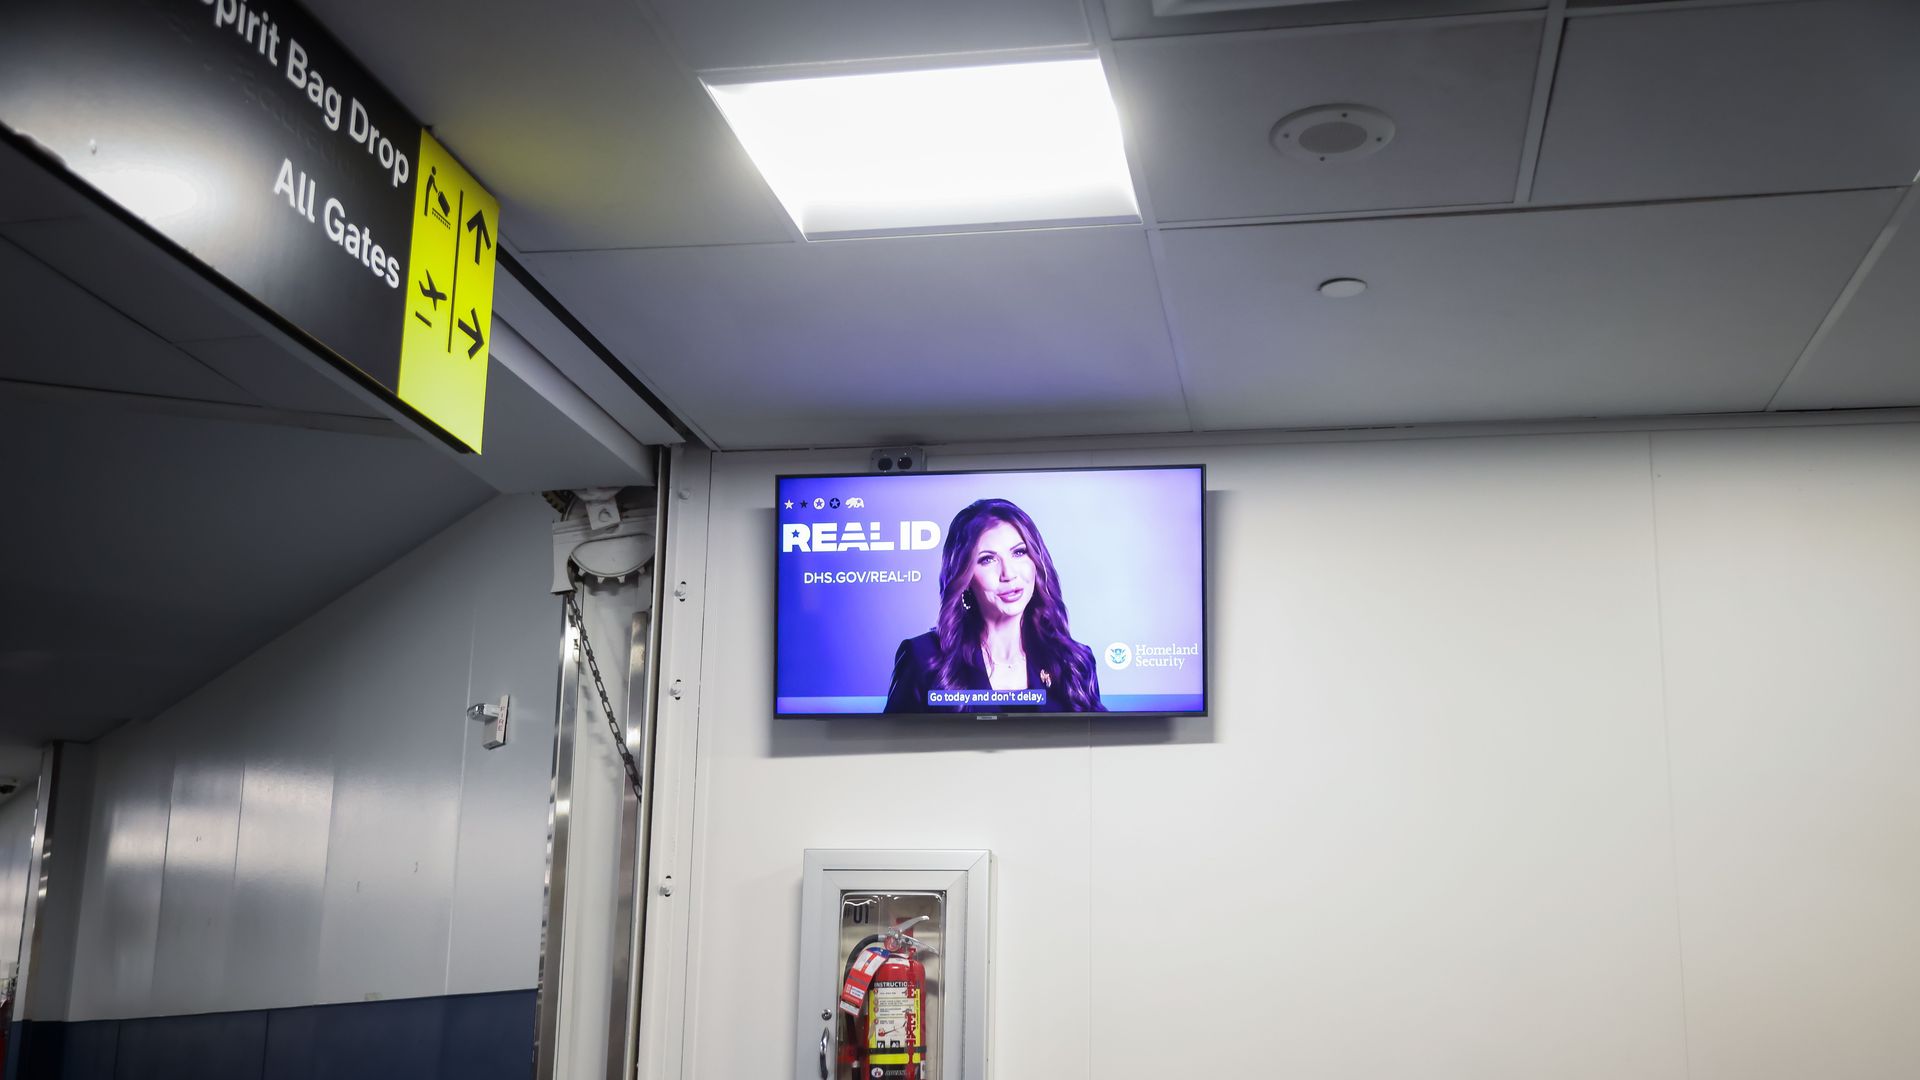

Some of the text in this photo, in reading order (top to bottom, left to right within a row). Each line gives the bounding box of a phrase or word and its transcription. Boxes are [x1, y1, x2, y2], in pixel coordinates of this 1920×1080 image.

[286, 37, 342, 131] Bag
[350, 97, 409, 187] Drop
[273, 157, 400, 289] All Gates
[782, 520, 941, 552] REAL ID
[803, 570, 921, 584] DHS.GOV/REAL-ID
[1135, 643, 1198, 656] Homeland
[1135, 656, 1185, 670] Security
[929, 691, 1044, 704] Go today and don't delay.
[497, 705, 506, 732] FIRE
